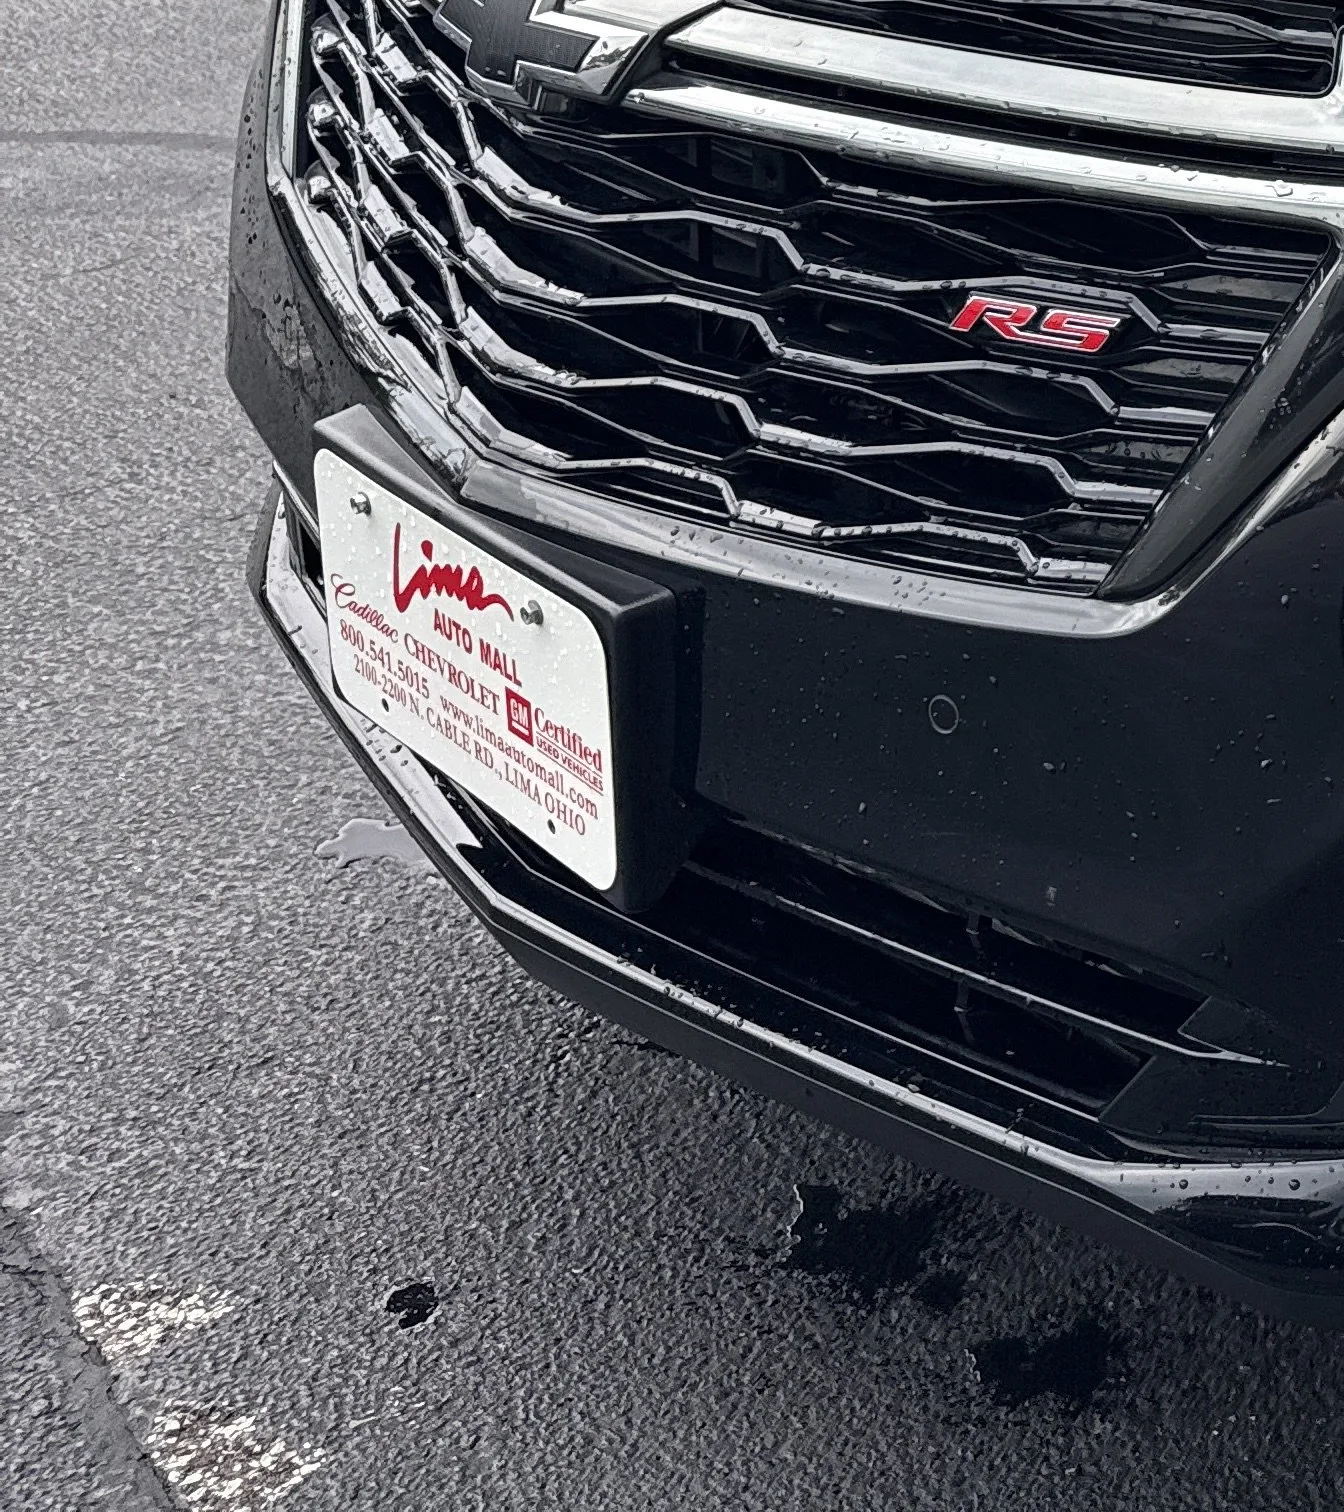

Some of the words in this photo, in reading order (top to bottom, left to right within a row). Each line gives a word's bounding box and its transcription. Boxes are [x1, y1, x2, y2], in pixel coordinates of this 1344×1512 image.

[950, 295, 1121, 352] RS
[393, 522, 515, 622] Lima
[330, 573, 399, 643] Cadillac
[403, 633, 500, 715] CHEVROLET
[433, 607, 473, 655] AUTO
[478, 637, 522, 687] MALL
[340, 619, 430, 700] 800.541.5015
[440, 695, 599, 820] www.limaautomall.com
[353, 653, 406, 707] 2100-2200
[409, 693, 425, 720] N.
[426, 706, 472, 755] CABLE
[504, 760, 543, 807] LIMA
[544, 791, 586, 836] OHIO
[510, 697, 529, 729] GM
[534, 707, 603, 774] Certified
[536, 735, 560, 760] USED
[561, 753, 604, 792] VEHICLES
